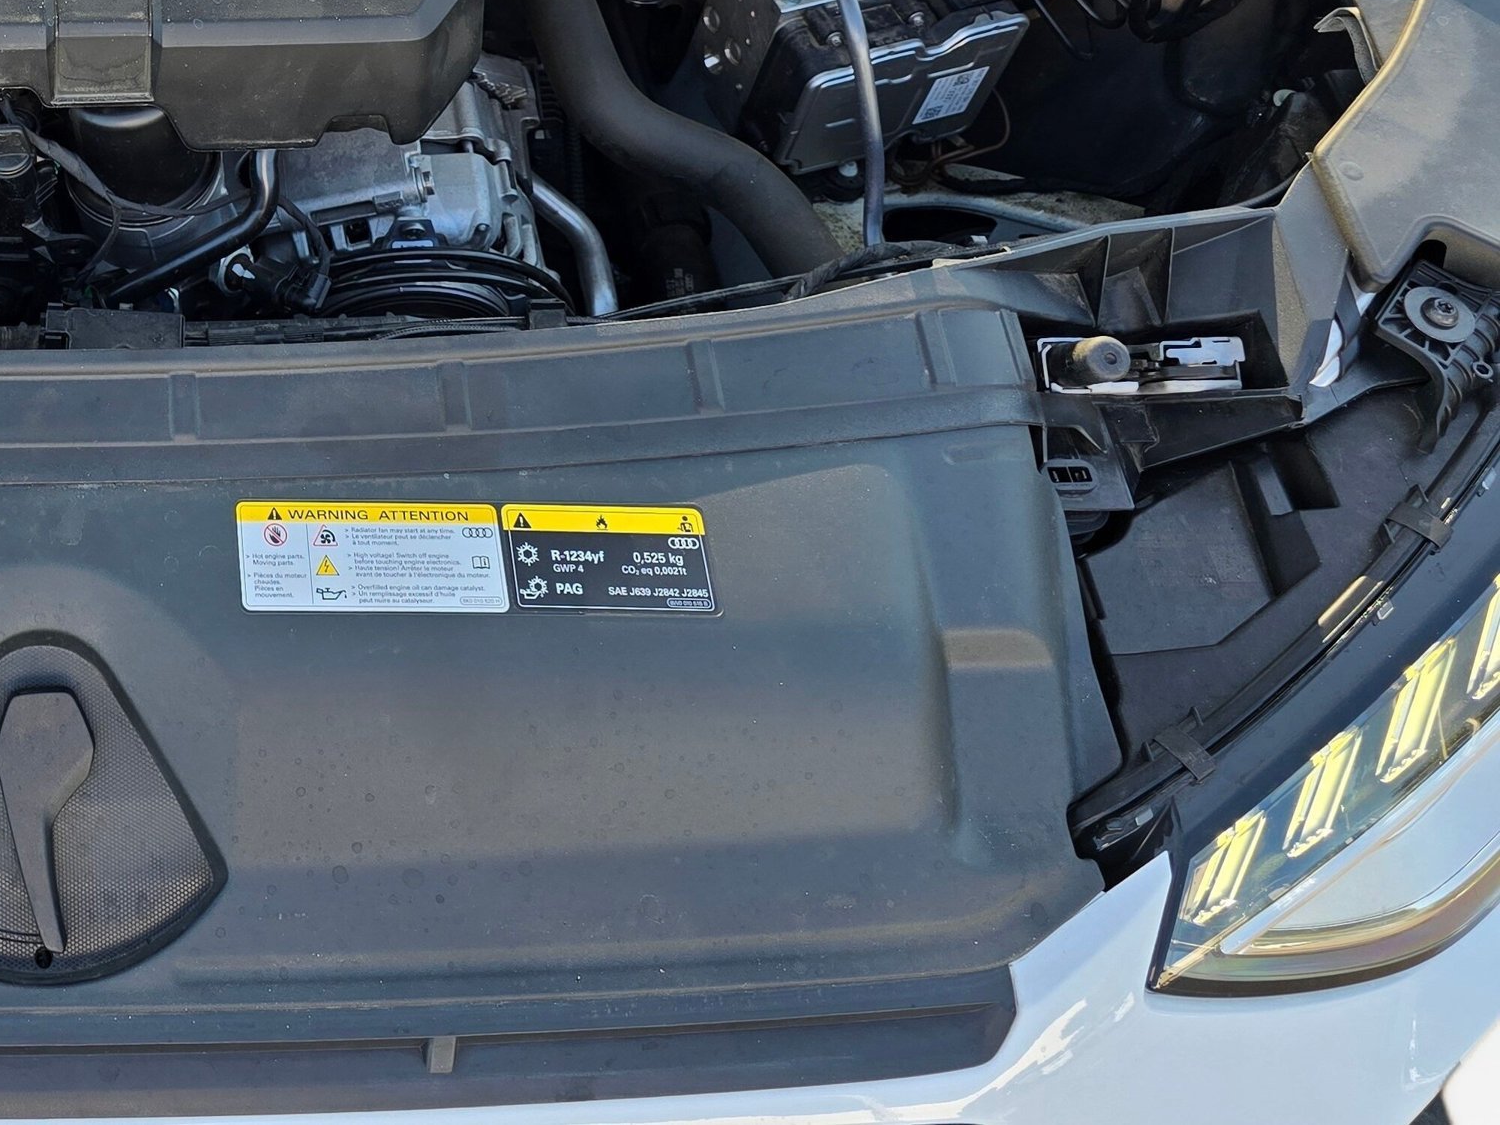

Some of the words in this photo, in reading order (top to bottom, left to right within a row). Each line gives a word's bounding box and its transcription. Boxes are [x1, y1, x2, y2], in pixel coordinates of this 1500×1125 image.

[288, 509, 369, 520] WARNING
[378, 510, 469, 521] ATTENTION
[550, 549, 605, 564] R-1234yf
[632, 552, 666, 564] 0,525
[668, 552, 684, 566] kg
[552, 563, 577, 572] GWP
[577, 564, 584, 573] 4
[640, 567, 653, 576] eq
[654, 566, 688, 576] 0,0021t
[433, 584, 458, 592] damage
[555, 582, 584, 595] PAG
[608, 586, 628, 596] SAE
[629, 587, 651, 596] J639
[652, 588, 680, 597] J2842
[681, 588, 709, 598] J2845
